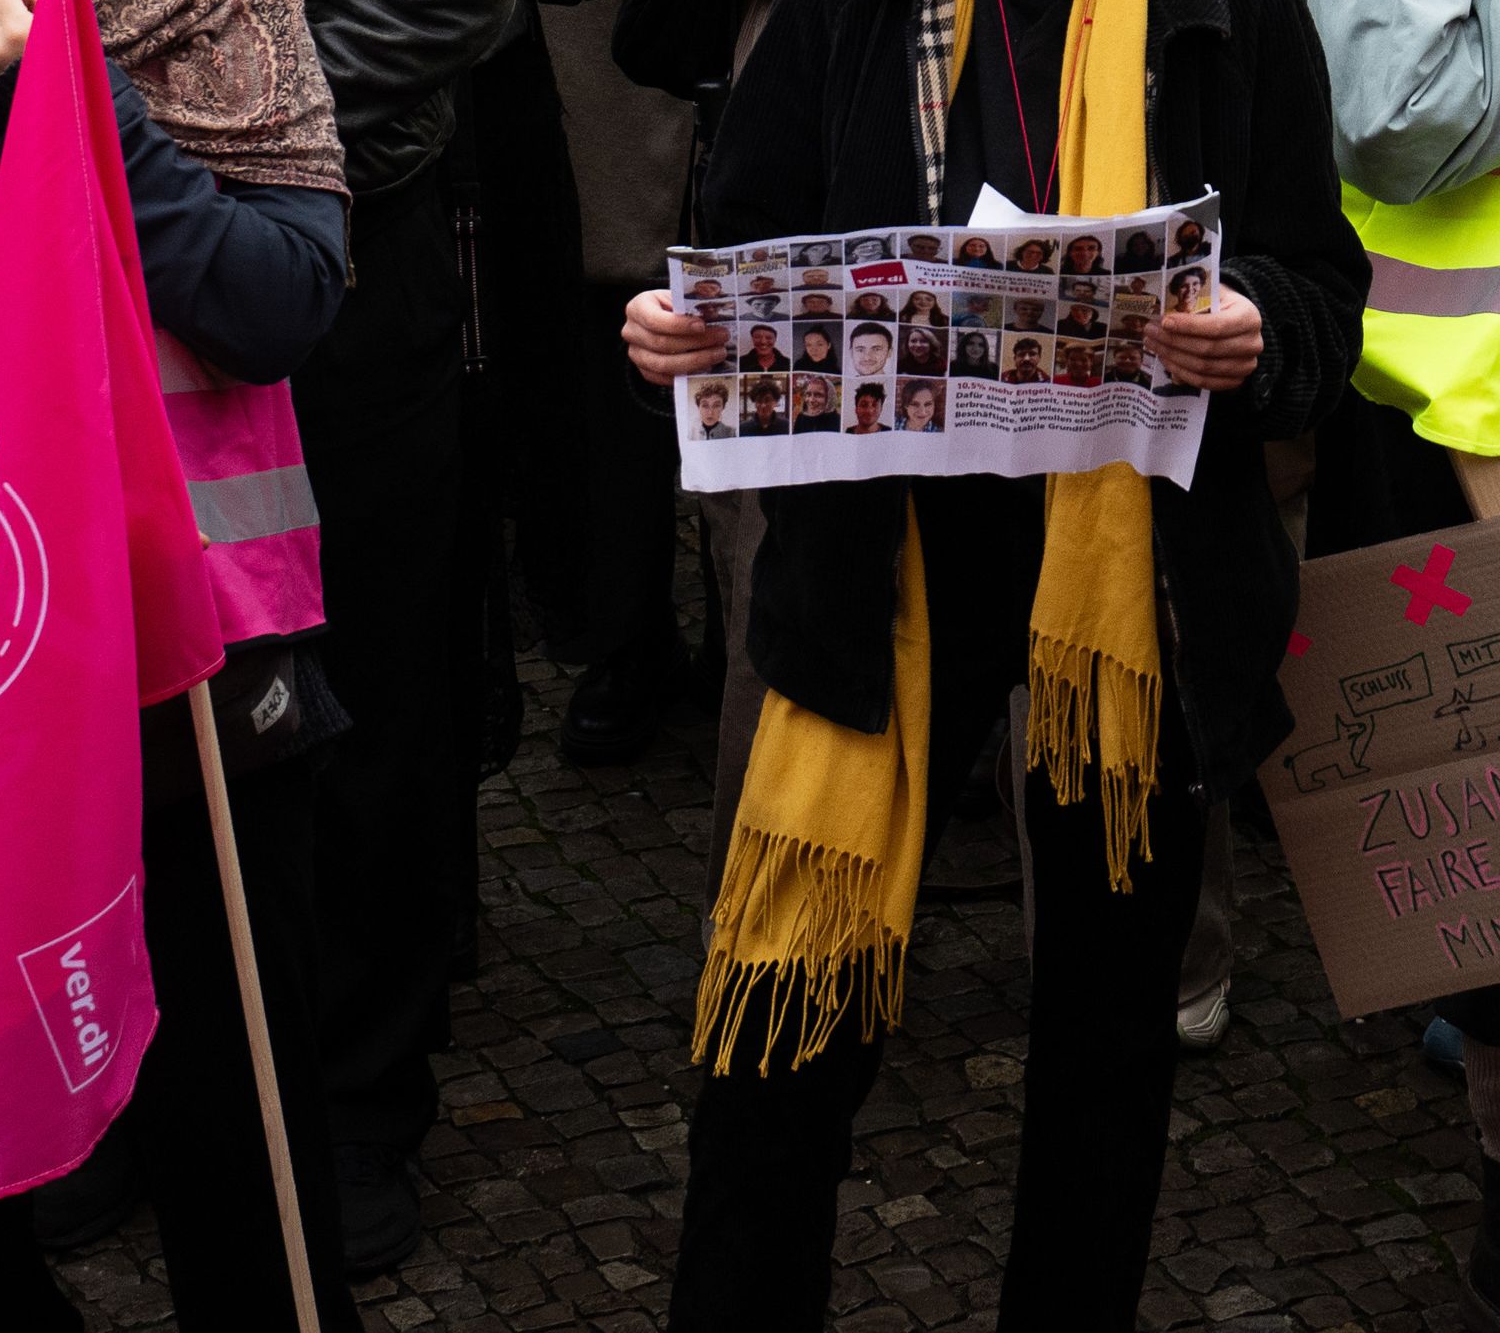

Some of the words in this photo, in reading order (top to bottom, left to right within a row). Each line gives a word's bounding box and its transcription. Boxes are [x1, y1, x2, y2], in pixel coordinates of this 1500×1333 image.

[956, 391, 984, 400] Dafür
[987, 394, 1007, 404] sind
[1009, 398, 1025, 406] wir
[1063, 399, 1091, 408] Lehre
[1112, 393, 1158, 415] Forschung
[1012, 407, 1028, 415] Wir
[1030, 405, 1064, 414] wollen
[1065, 408, 1091, 416] mehr
[954, 419, 988, 428] wollen
[1039, 414, 1073, 424] wollen
[1350, 668, 1412, 703] SCHLUSS
[60, 941, 111, 1069] ver.di
